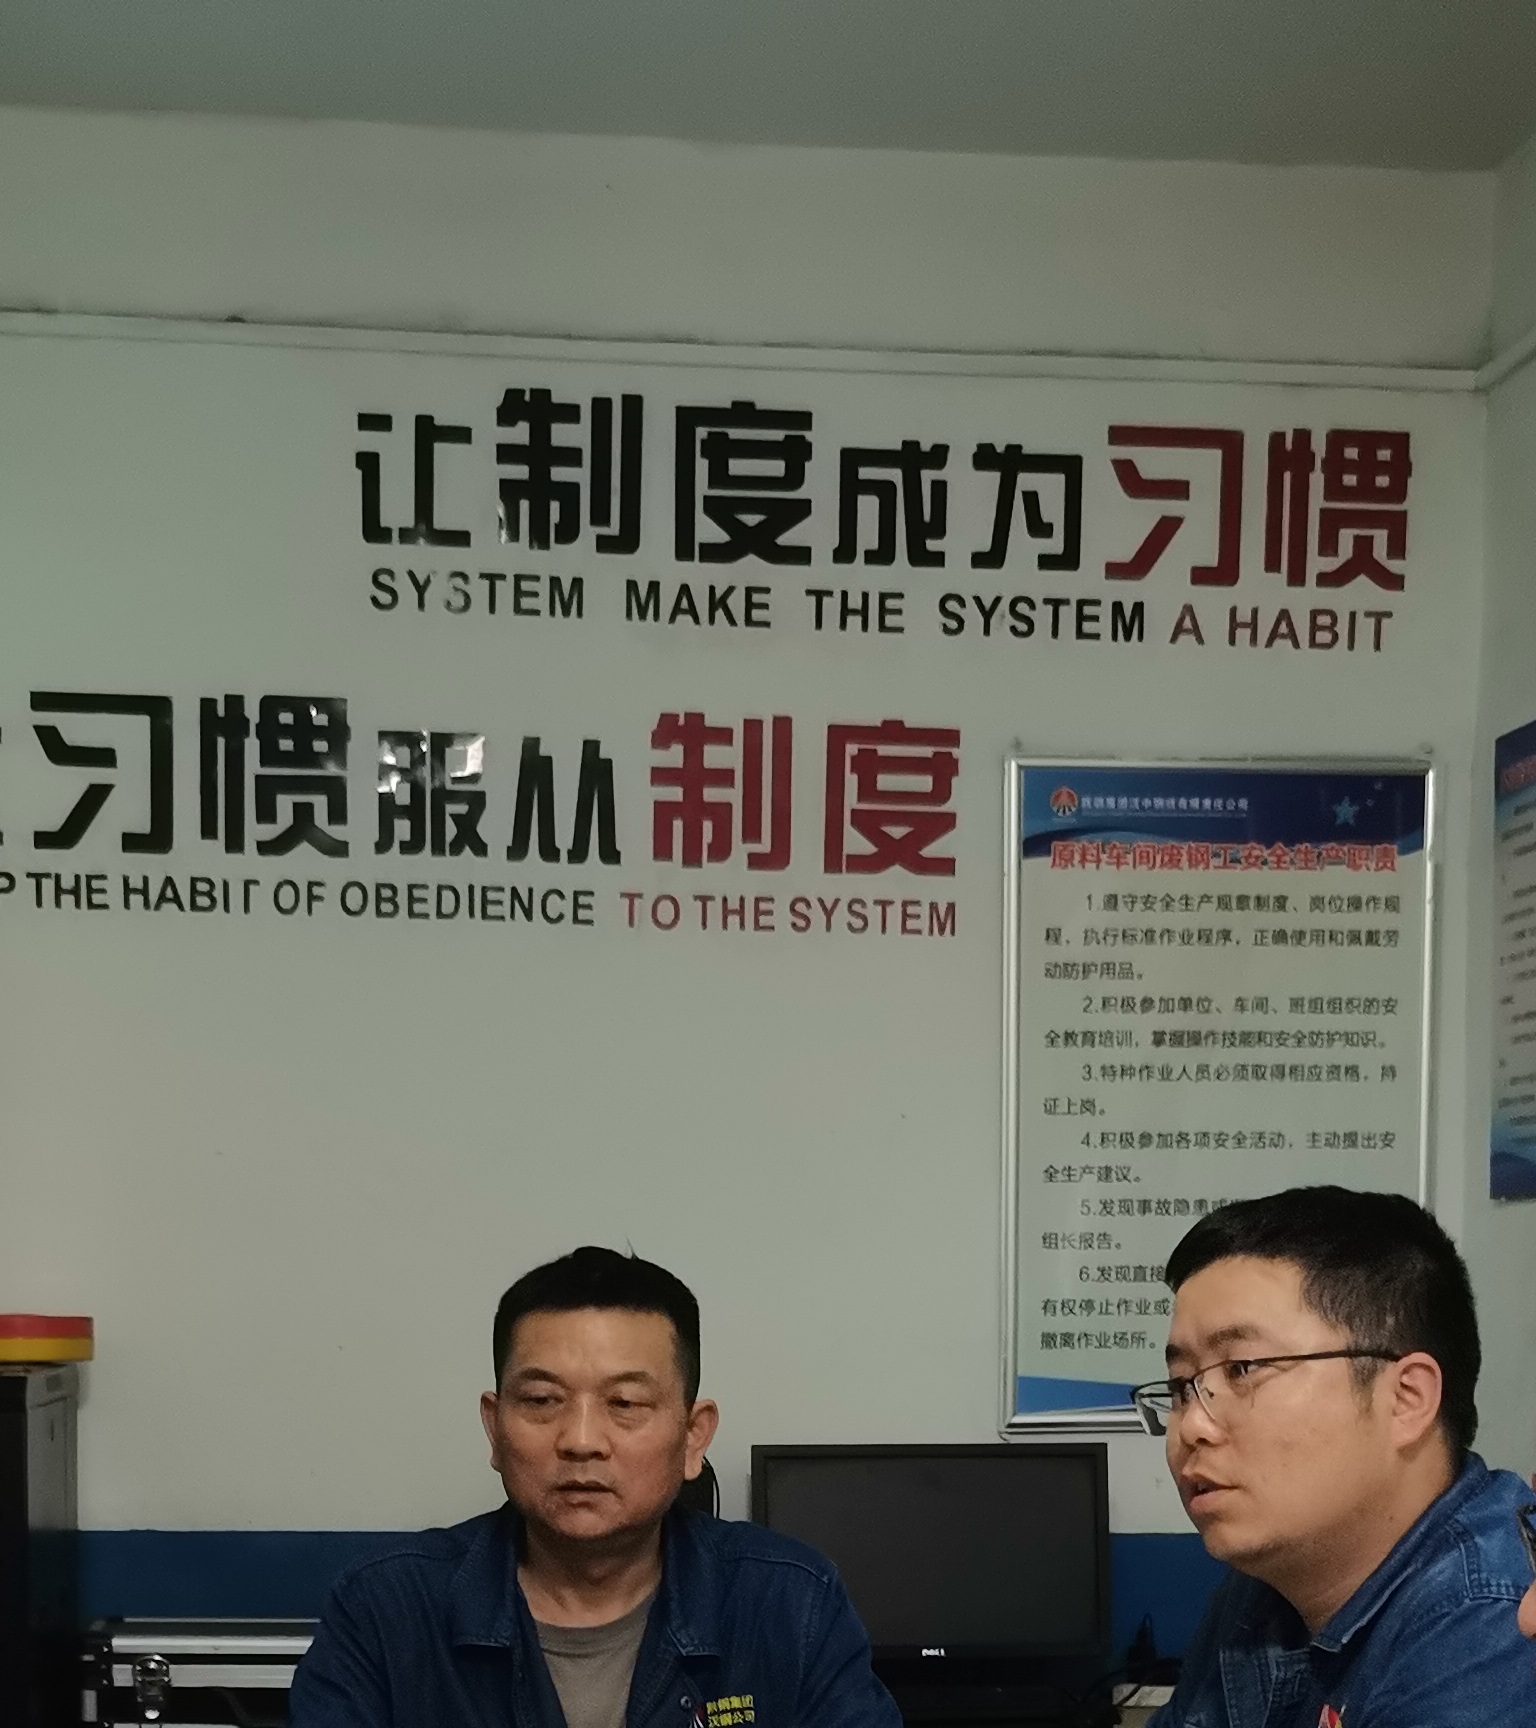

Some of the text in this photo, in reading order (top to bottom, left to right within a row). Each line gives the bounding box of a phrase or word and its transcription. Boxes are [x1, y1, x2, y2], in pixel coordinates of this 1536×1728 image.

[355, 387, 1413, 592] 让制度成为习惯
[370, 567, 1394, 652] SYSTEM MAKE THE SYSTEM A HABIT
[1050, 839, 1399, 873] 原料车间废钢工安全生产职责
[26, 871, 109, 911] THE
[273, 878, 325, 917] OF
[340, 880, 596, 928] OBEDIENCE
[620, 892, 682, 932] TO
[694, 894, 775, 933] THE
[788, 896, 958, 939] SYSTEM
[1044, 959, 1144, 981] 动防护用品。
[1043, 1097, 1107, 1117] 证上岗。
[1042, 1164, 1142, 1185] 全生产建议。
[1041, 1231, 1122, 1251] 组长报告。
[1040, 1330, 1156, 1350] 撤离作业场所。
